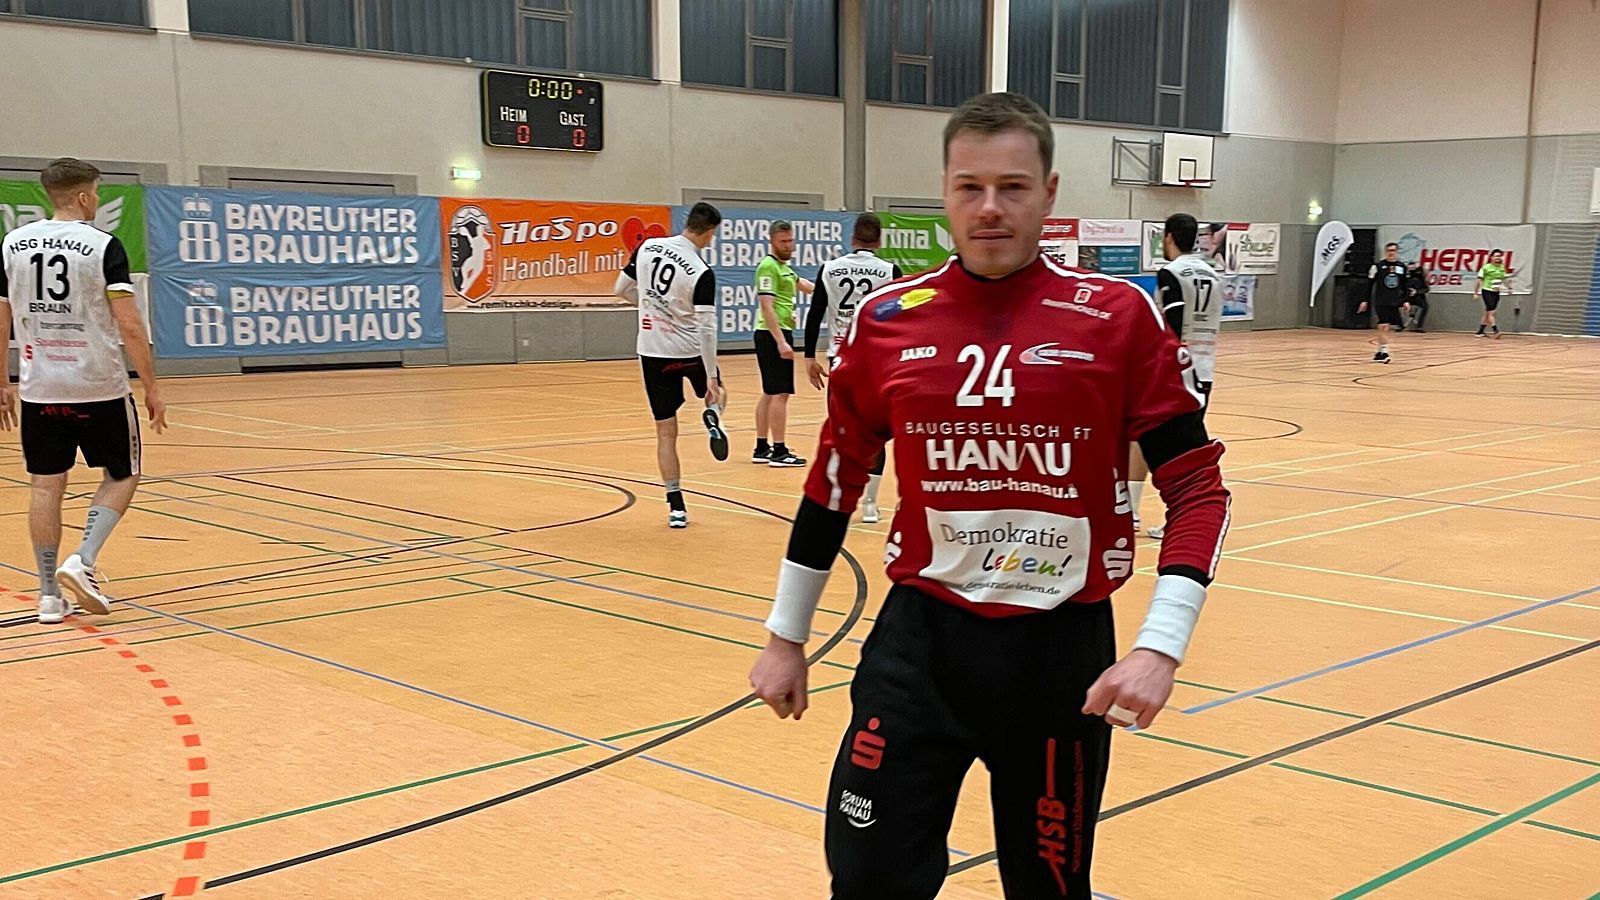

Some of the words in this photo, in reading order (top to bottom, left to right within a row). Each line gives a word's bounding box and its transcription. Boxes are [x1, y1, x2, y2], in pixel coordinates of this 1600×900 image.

[529, 79, 572, 100] 0:00
[517, 125, 530, 144] 0
[573, 129, 586, 147] 0
[225, 203, 417, 234] BAYREUTHER
[720, 218, 842, 242] BAYRTHER
[9, 239, 38, 254] HSG
[43, 238, 94, 257] HANAU
[226, 234, 420, 265] BRAUHAUS
[880, 222, 932, 250] rima
[501, 250, 589, 282] Handball
[593, 248, 625, 273] mit
[663, 248, 696, 276] HANAU
[829, 268, 848, 278] HSG
[850, 267, 887, 279] HANAU
[1419, 248, 1515, 274] HERTL
[30, 252, 71, 302] 13
[651, 256, 676, 297] 19
[29, 302, 72, 314] BRAUN
[231, 284, 420, 313] BAYREUTHER
[1193, 279, 1212, 312] 17
[233, 312, 421, 346] BRAUHAUS
[899, 345, 938, 362] JAKO
[955, 343, 1017, 408] 24
[940, 522, 1069, 550] Demokratie
[1035, 796, 1067, 866] HSB
